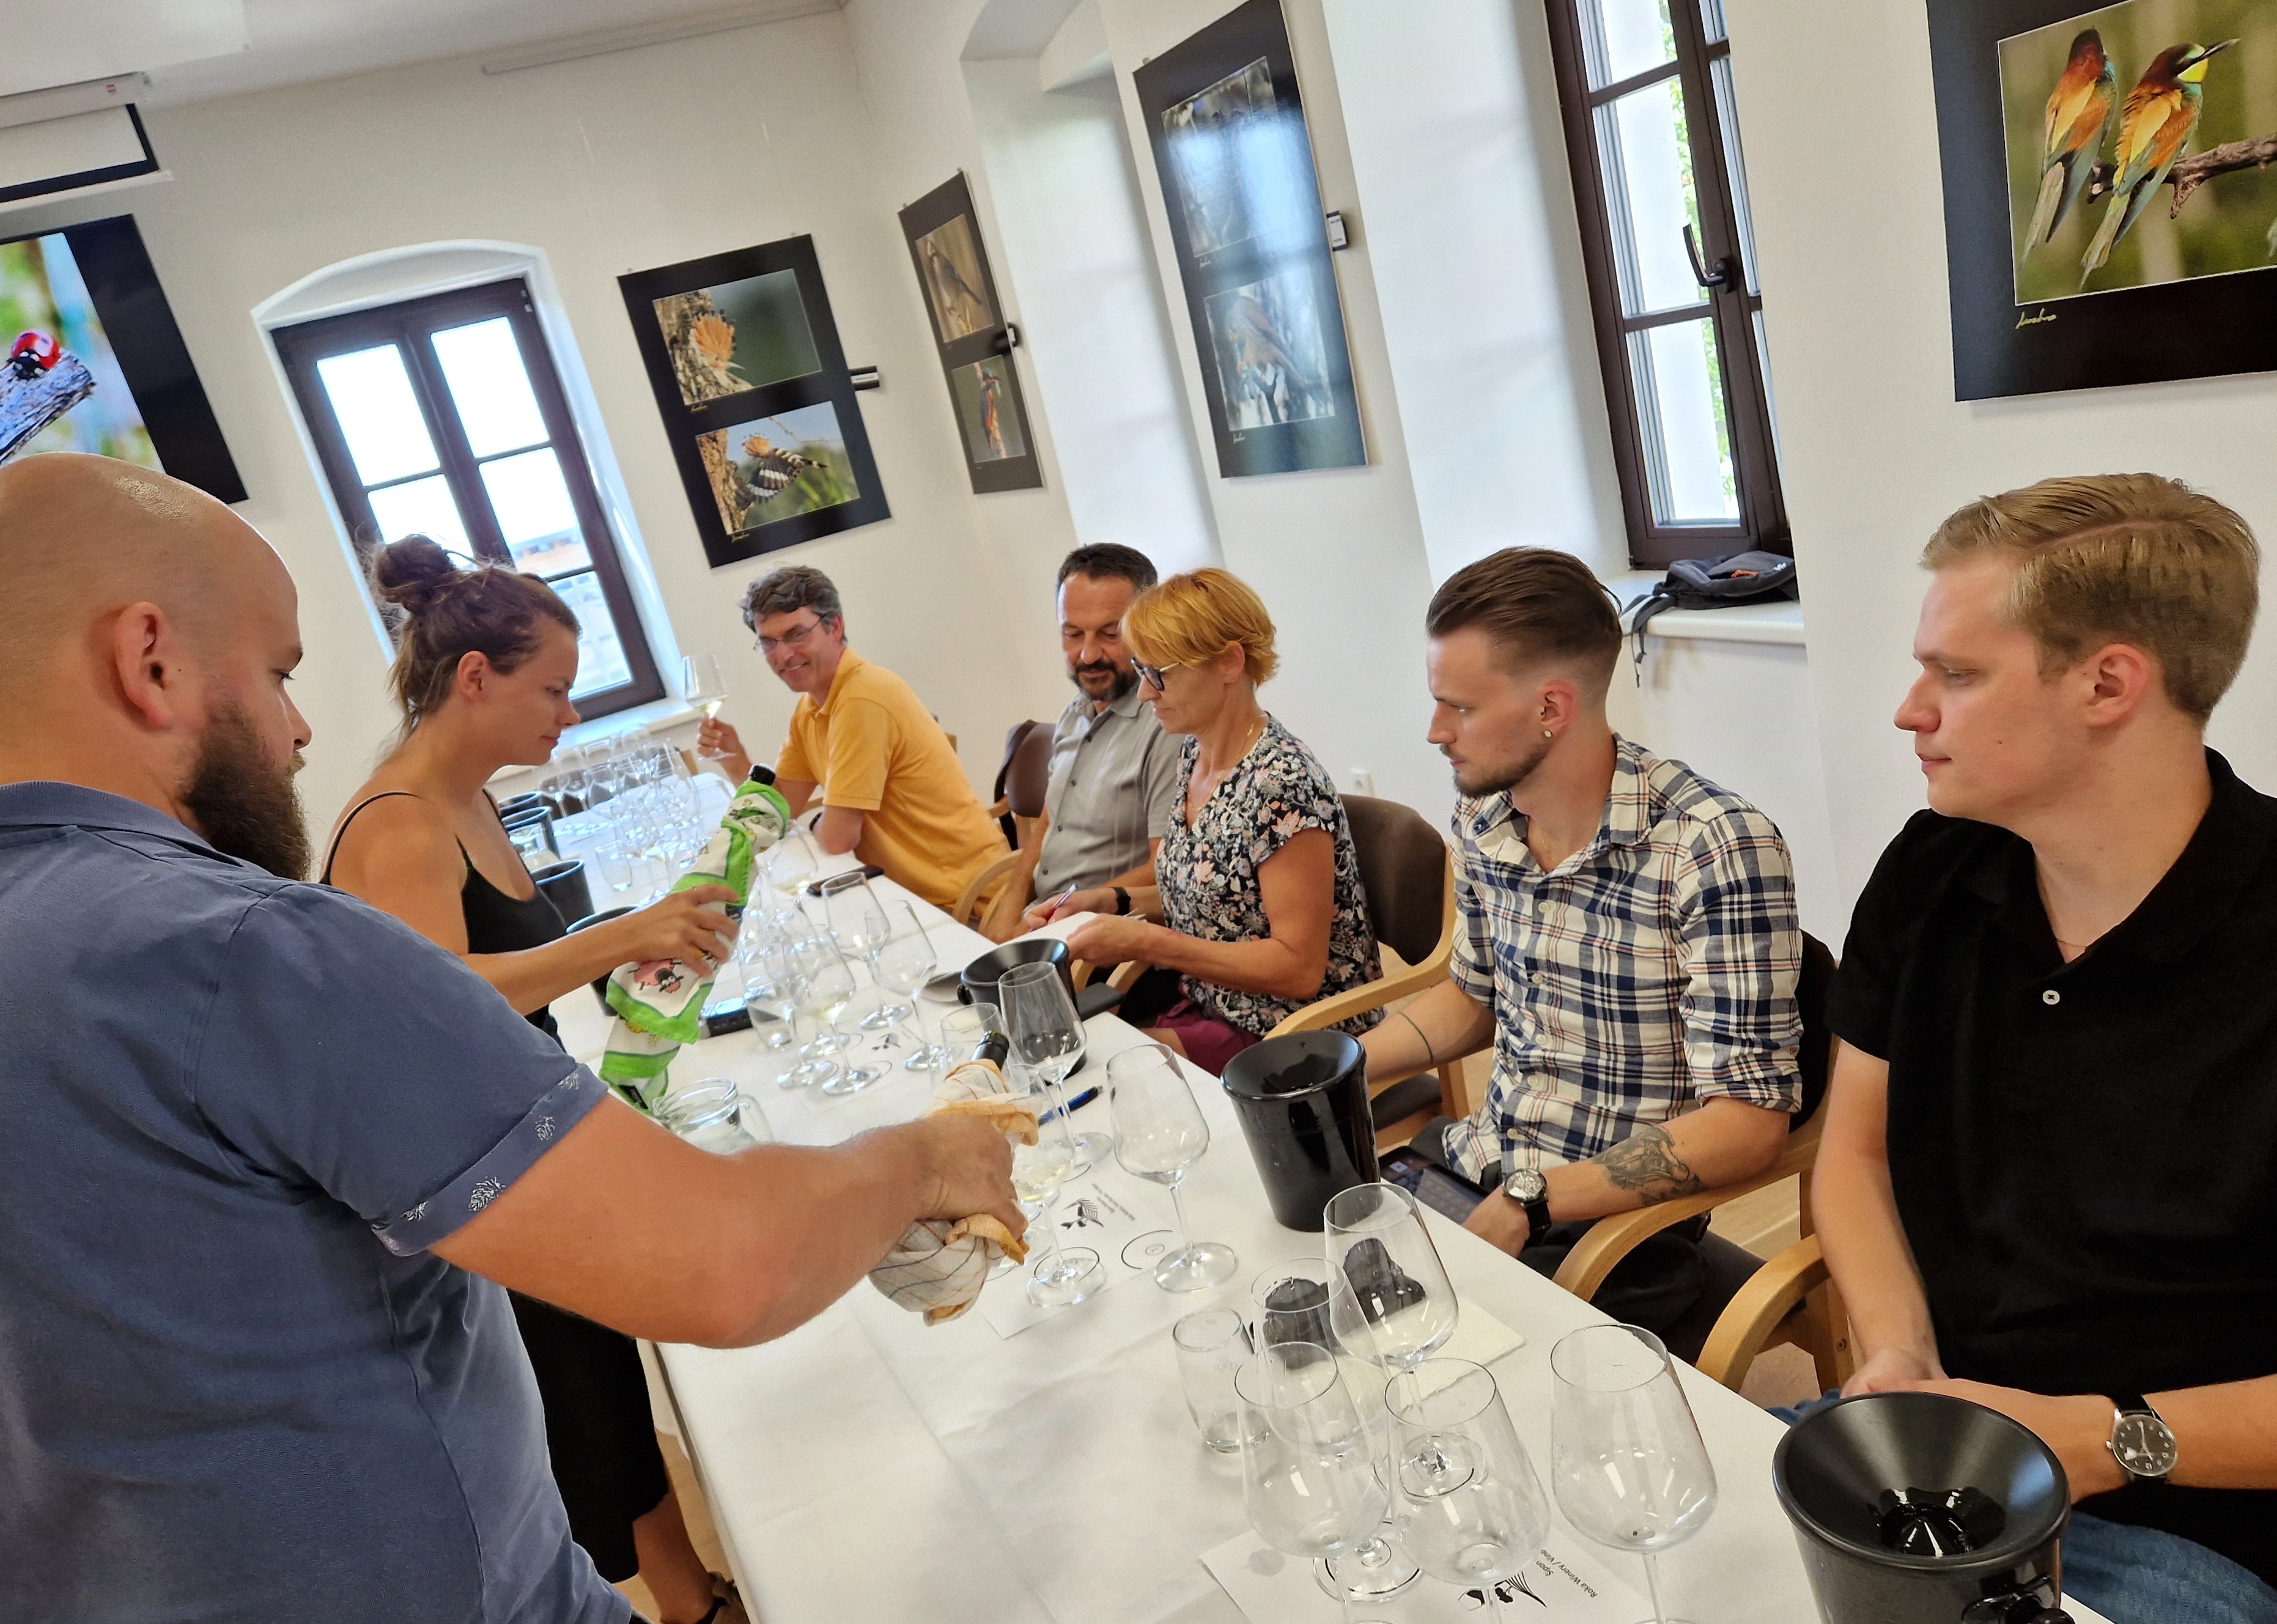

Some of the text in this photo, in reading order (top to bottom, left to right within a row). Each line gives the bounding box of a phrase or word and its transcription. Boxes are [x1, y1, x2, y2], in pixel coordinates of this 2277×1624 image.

[1540, 1549, 1555, 1562] Vino
[1559, 1564, 1581, 1585] Winery
[1581, 1582, 1598, 1598] Roka
